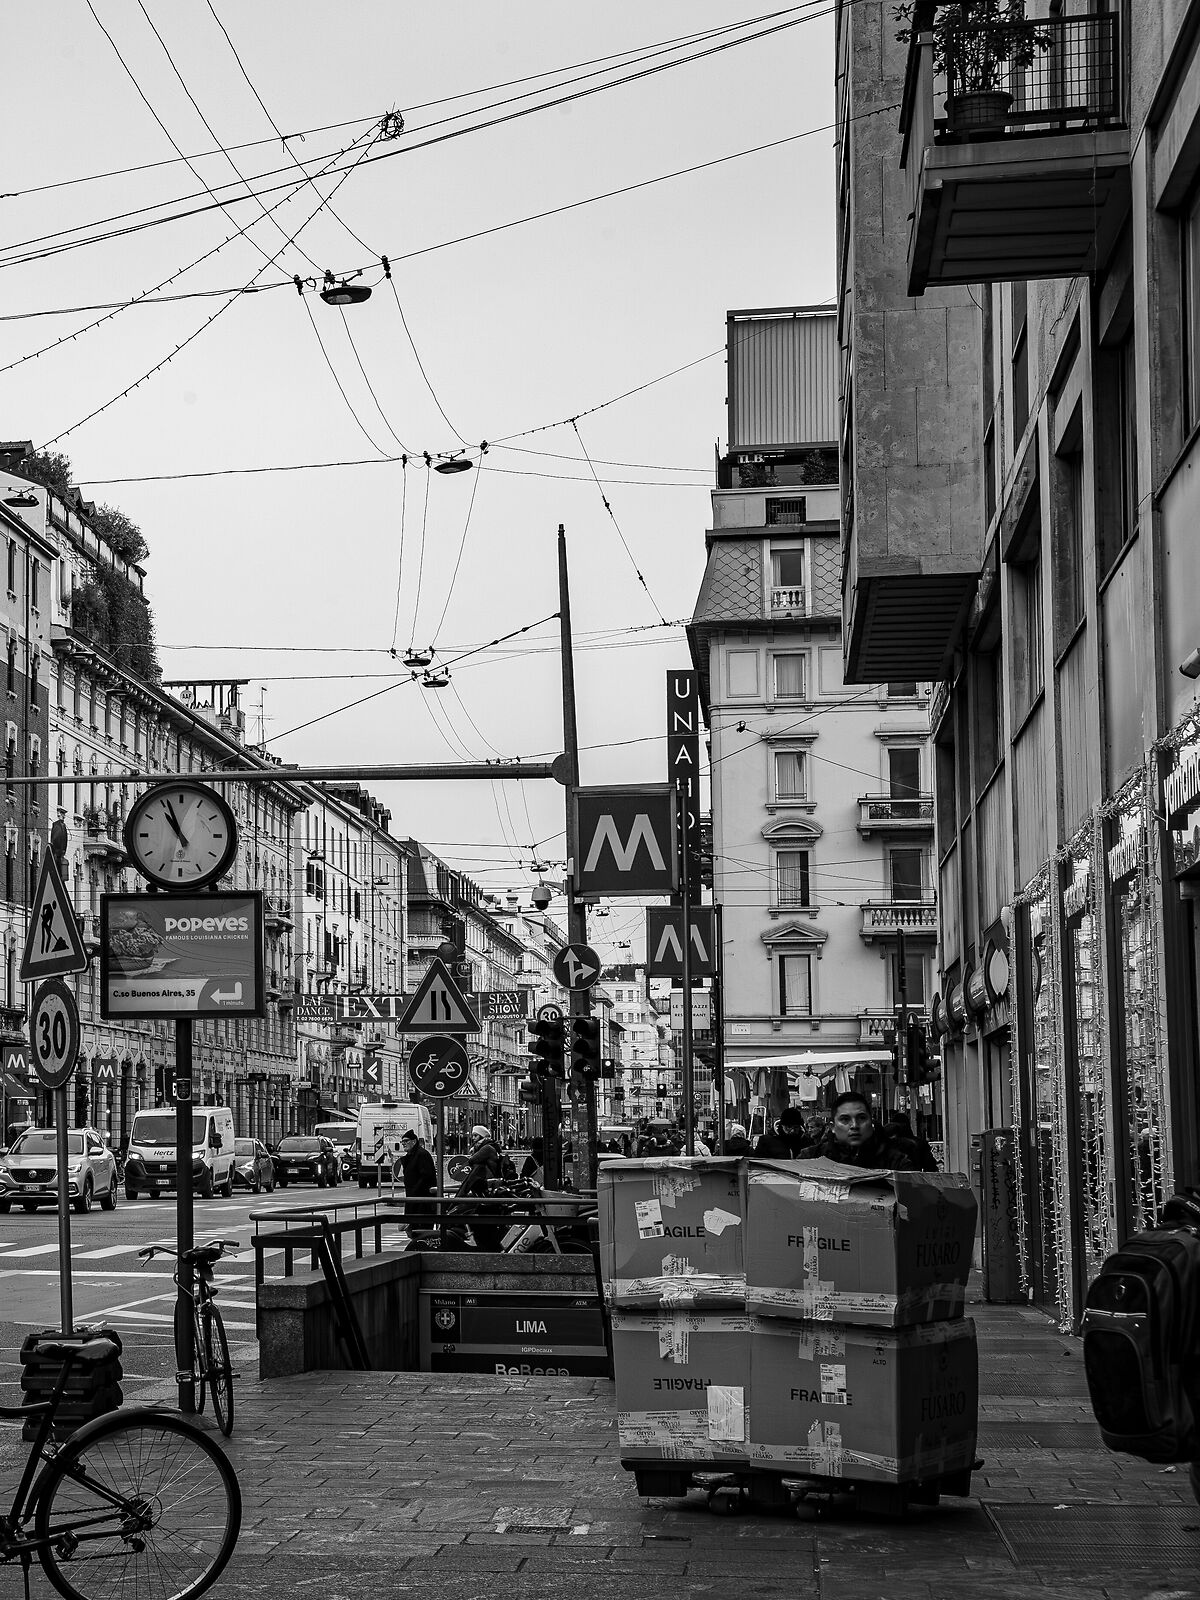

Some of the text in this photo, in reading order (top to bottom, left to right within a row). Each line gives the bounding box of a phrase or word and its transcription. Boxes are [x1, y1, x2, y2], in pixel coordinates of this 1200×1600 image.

[583, 813, 667, 872] M
[112, 990, 130, 998] C.so
[161, 989, 185, 998] Aires,
[185, 989, 196, 997] 35
[488, 993, 521, 1004] SEXY
[297, 1006, 330, 1016] DANCE
[489, 1004, 521, 1013] SHOW
[543, 1011, 557, 1021] 30
[39, 1010, 67, 1060] 30
[663, 1226, 706, 1238] AGILE
[787, 1235, 851, 1252] FRGILE
[915, 1241, 961, 1268] FUSARO
[515, 1319, 547, 1334] LIMA
[791, 1388, 852, 1406] FRAE
[921, 1391, 966, 1422] FUSARO
